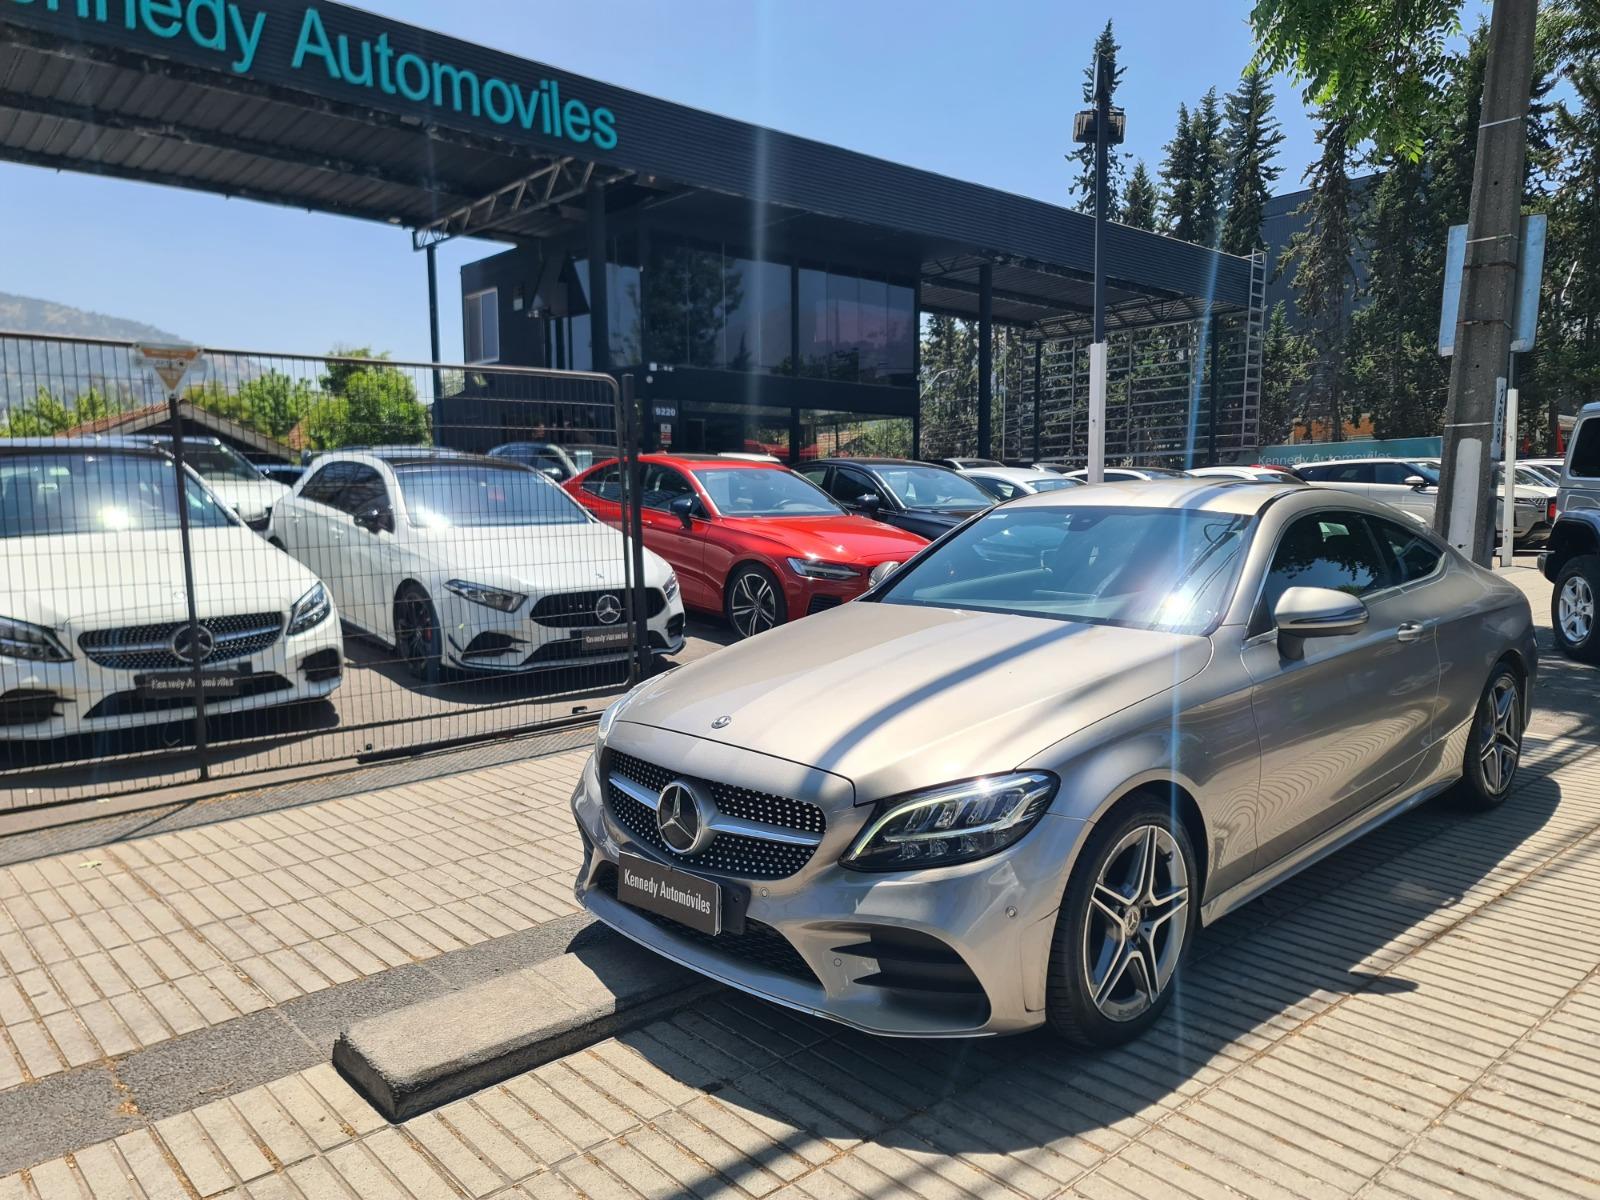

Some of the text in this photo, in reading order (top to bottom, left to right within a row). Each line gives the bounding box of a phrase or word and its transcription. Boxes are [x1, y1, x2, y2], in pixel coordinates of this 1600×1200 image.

[10, 0, 618, 149] nedy Automoviles
[1257, 453, 1310, 466] Kennedy
[623, 868, 711, 915] Kennedy Automóviles
